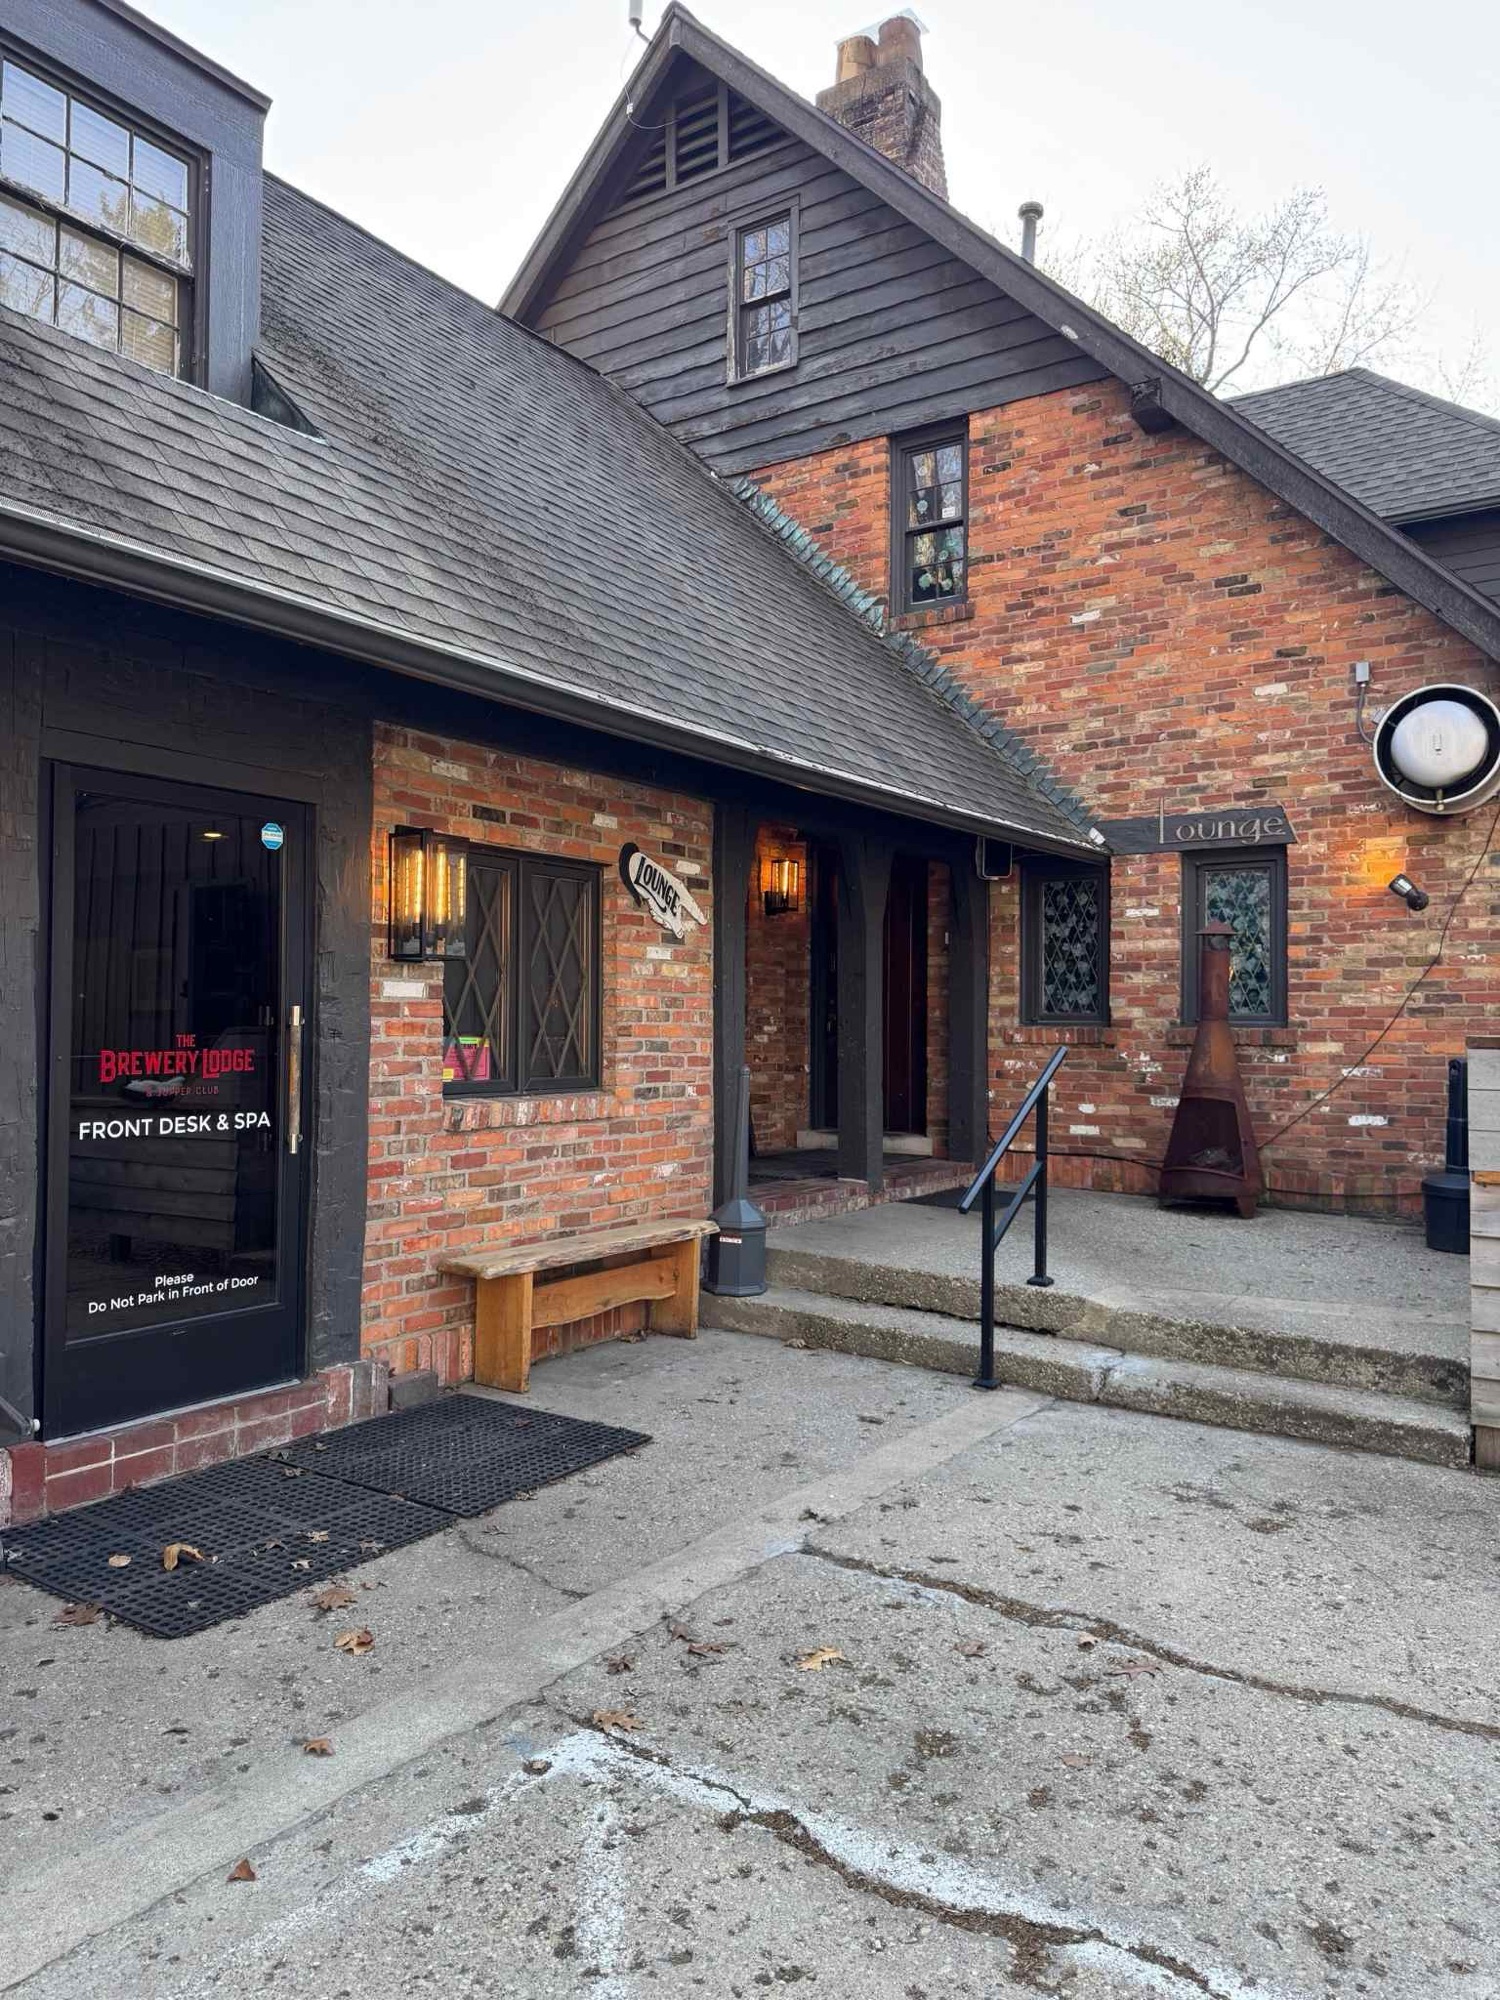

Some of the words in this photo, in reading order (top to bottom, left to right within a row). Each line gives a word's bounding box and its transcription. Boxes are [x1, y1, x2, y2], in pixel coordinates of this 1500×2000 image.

[1160, 797, 1286, 844] Lounge
[634, 856, 680, 917] LOUNGE
[176, 1034, 196, 1047] THE
[100, 1050, 199, 1083] BREWERY
[202, 1049, 255, 1078] LODGE
[195, 1085, 219, 1095] CLUB
[79, 1119, 153, 1140] FRONT
[159, 1115, 212, 1135] DESK
[216, 1114, 229, 1131] &
[234, 1112, 271, 1130] SPA
[88, 1302, 107, 1314] Do
[110, 1297, 134, 1310] Not
[138, 1290, 165, 1306] Park
[168, 1288, 179, 1300] in
[182, 1283, 214, 1297] Front
[216, 1279, 229, 1292] of
[231, 1275, 258, 1289] Door
[155, 1273, 194, 1288] Please
